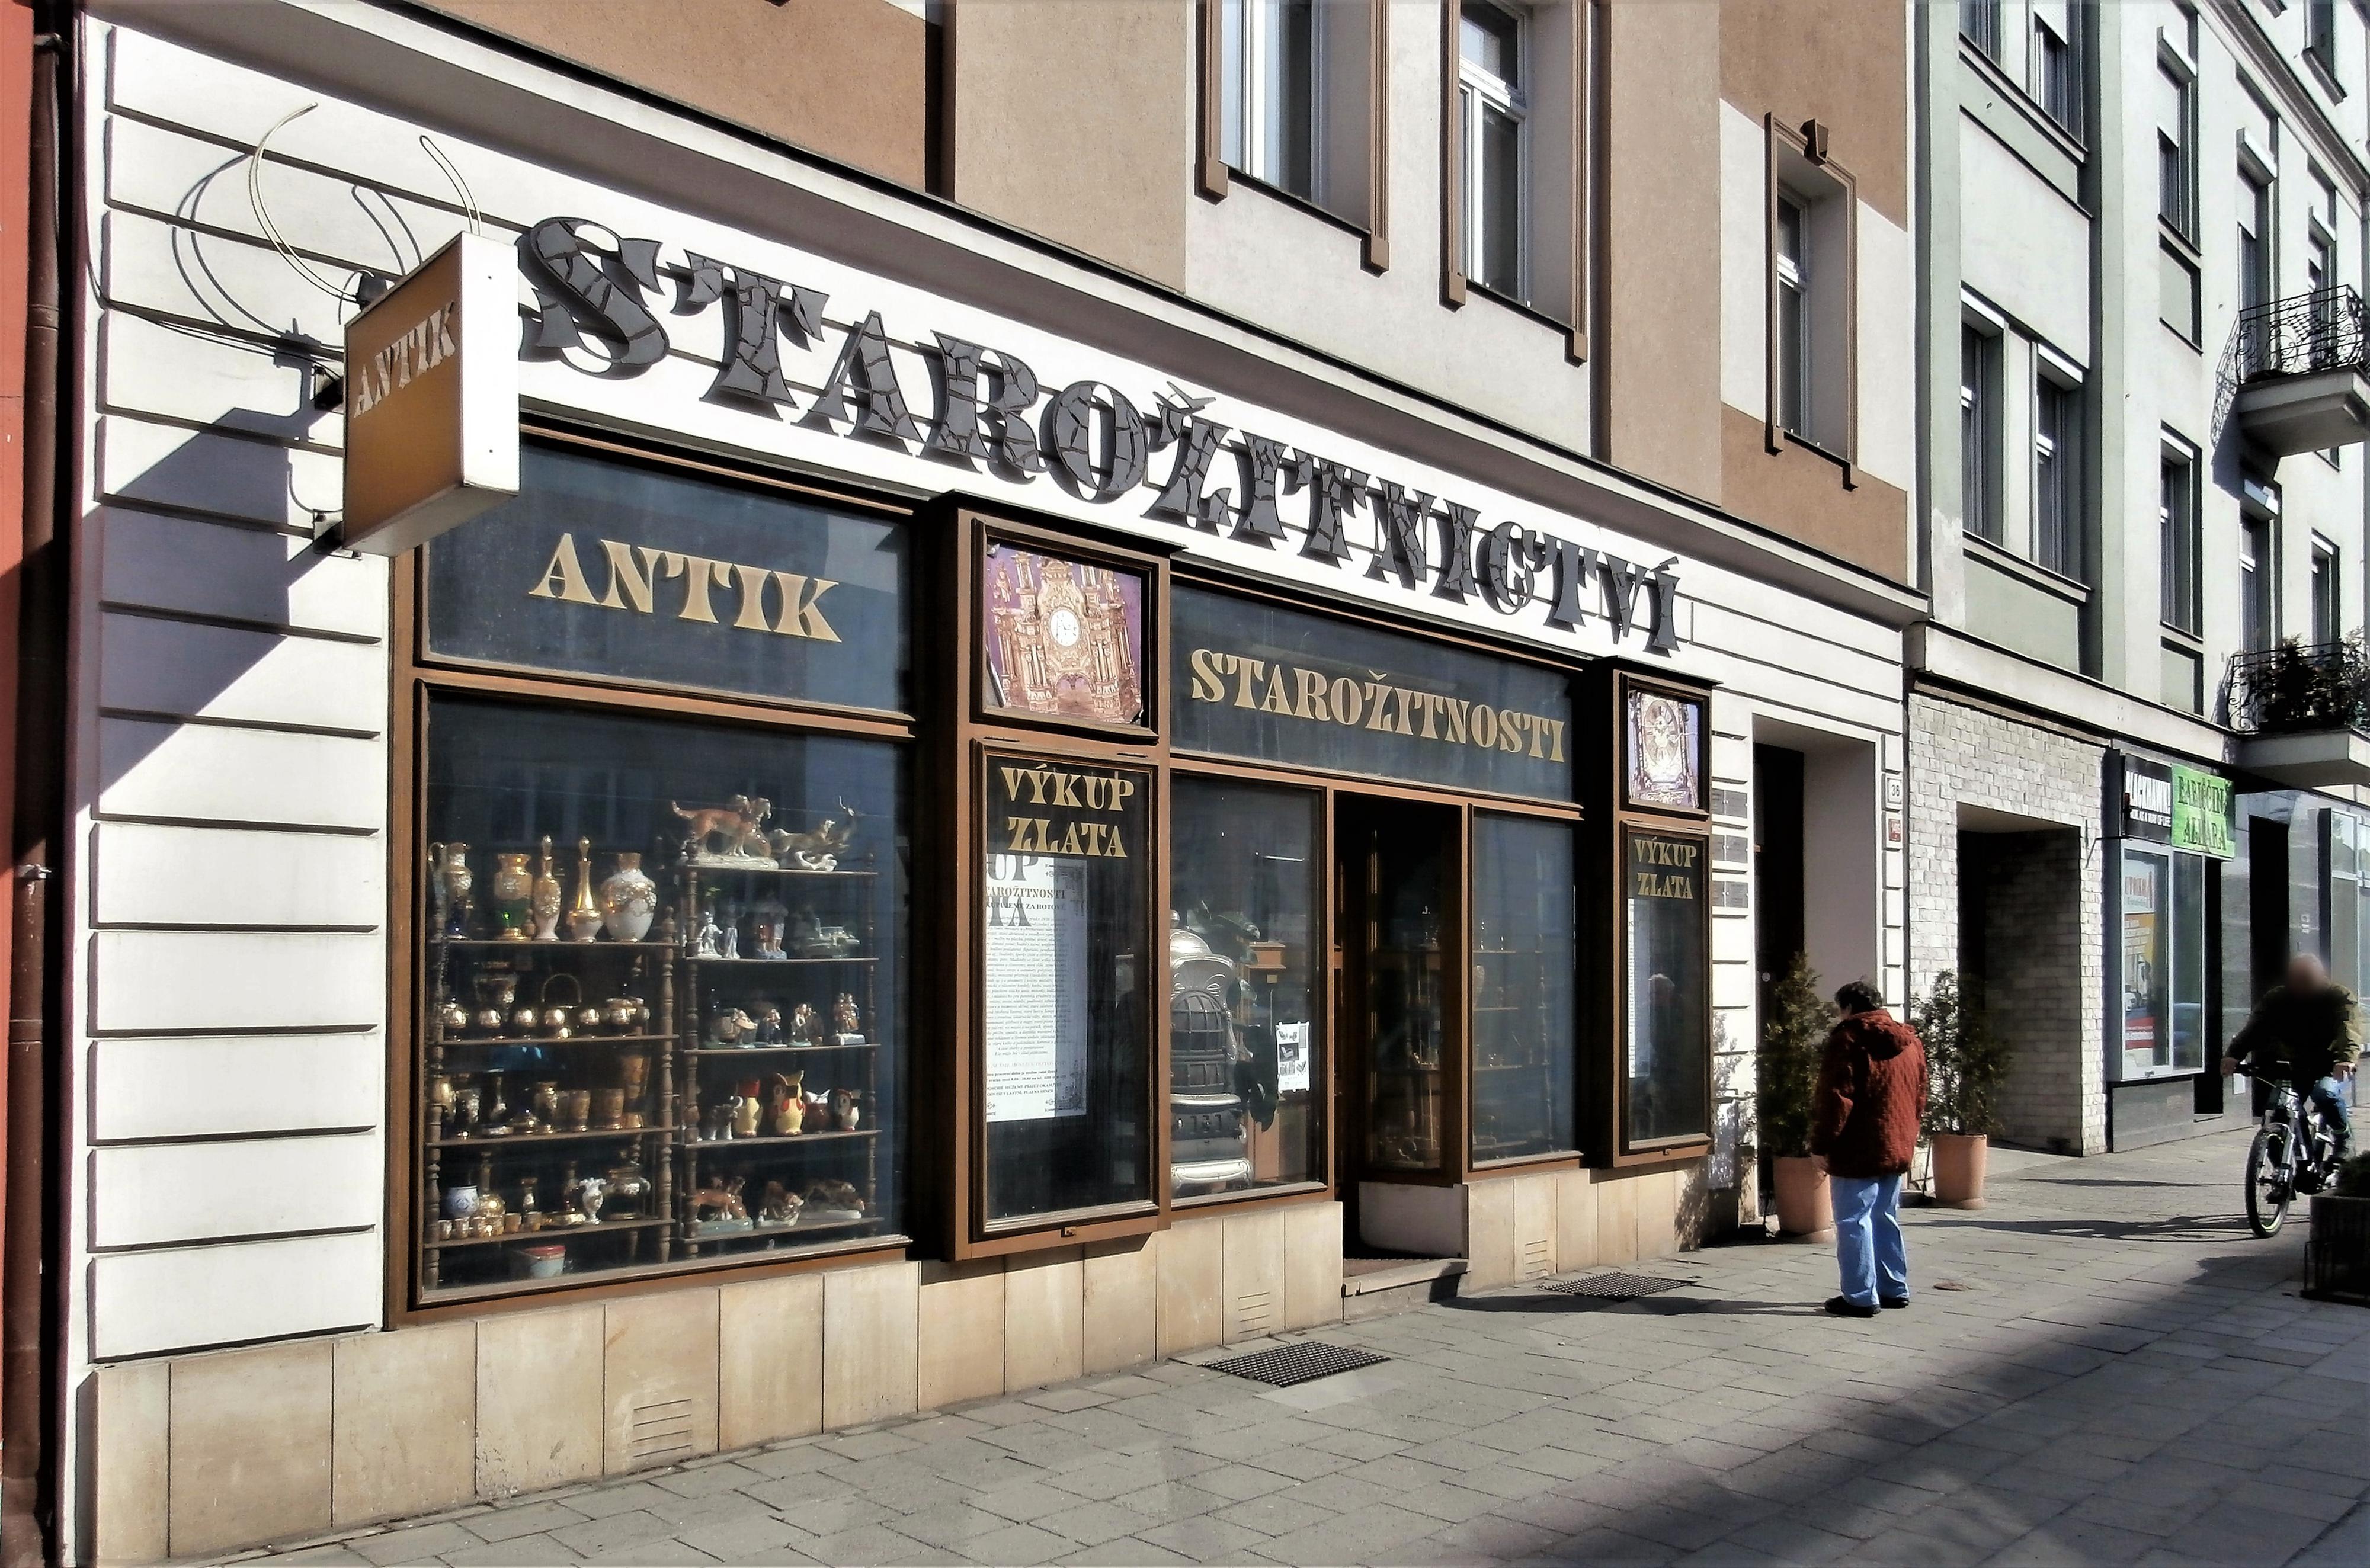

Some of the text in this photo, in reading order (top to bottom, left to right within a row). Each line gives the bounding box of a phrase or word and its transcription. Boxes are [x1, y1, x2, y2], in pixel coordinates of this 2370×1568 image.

[353, 301, 456, 418] ANTIK
[530, 216, 1682, 653] STAROŽITNICTVÍ
[528, 533, 843, 643] ANTIK
[1190, 649, 1566, 763] STAROŽITNOSTI
[1000, 763, 1135, 812] VÝKUP
[1008, 816, 1128, 858] ZLATA
[1634, 836, 1697, 867] VÝKUP
[985, 886, 1066, 899] TAROŽITNOSTI
[1637, 872, 1693, 899] ZLATA
